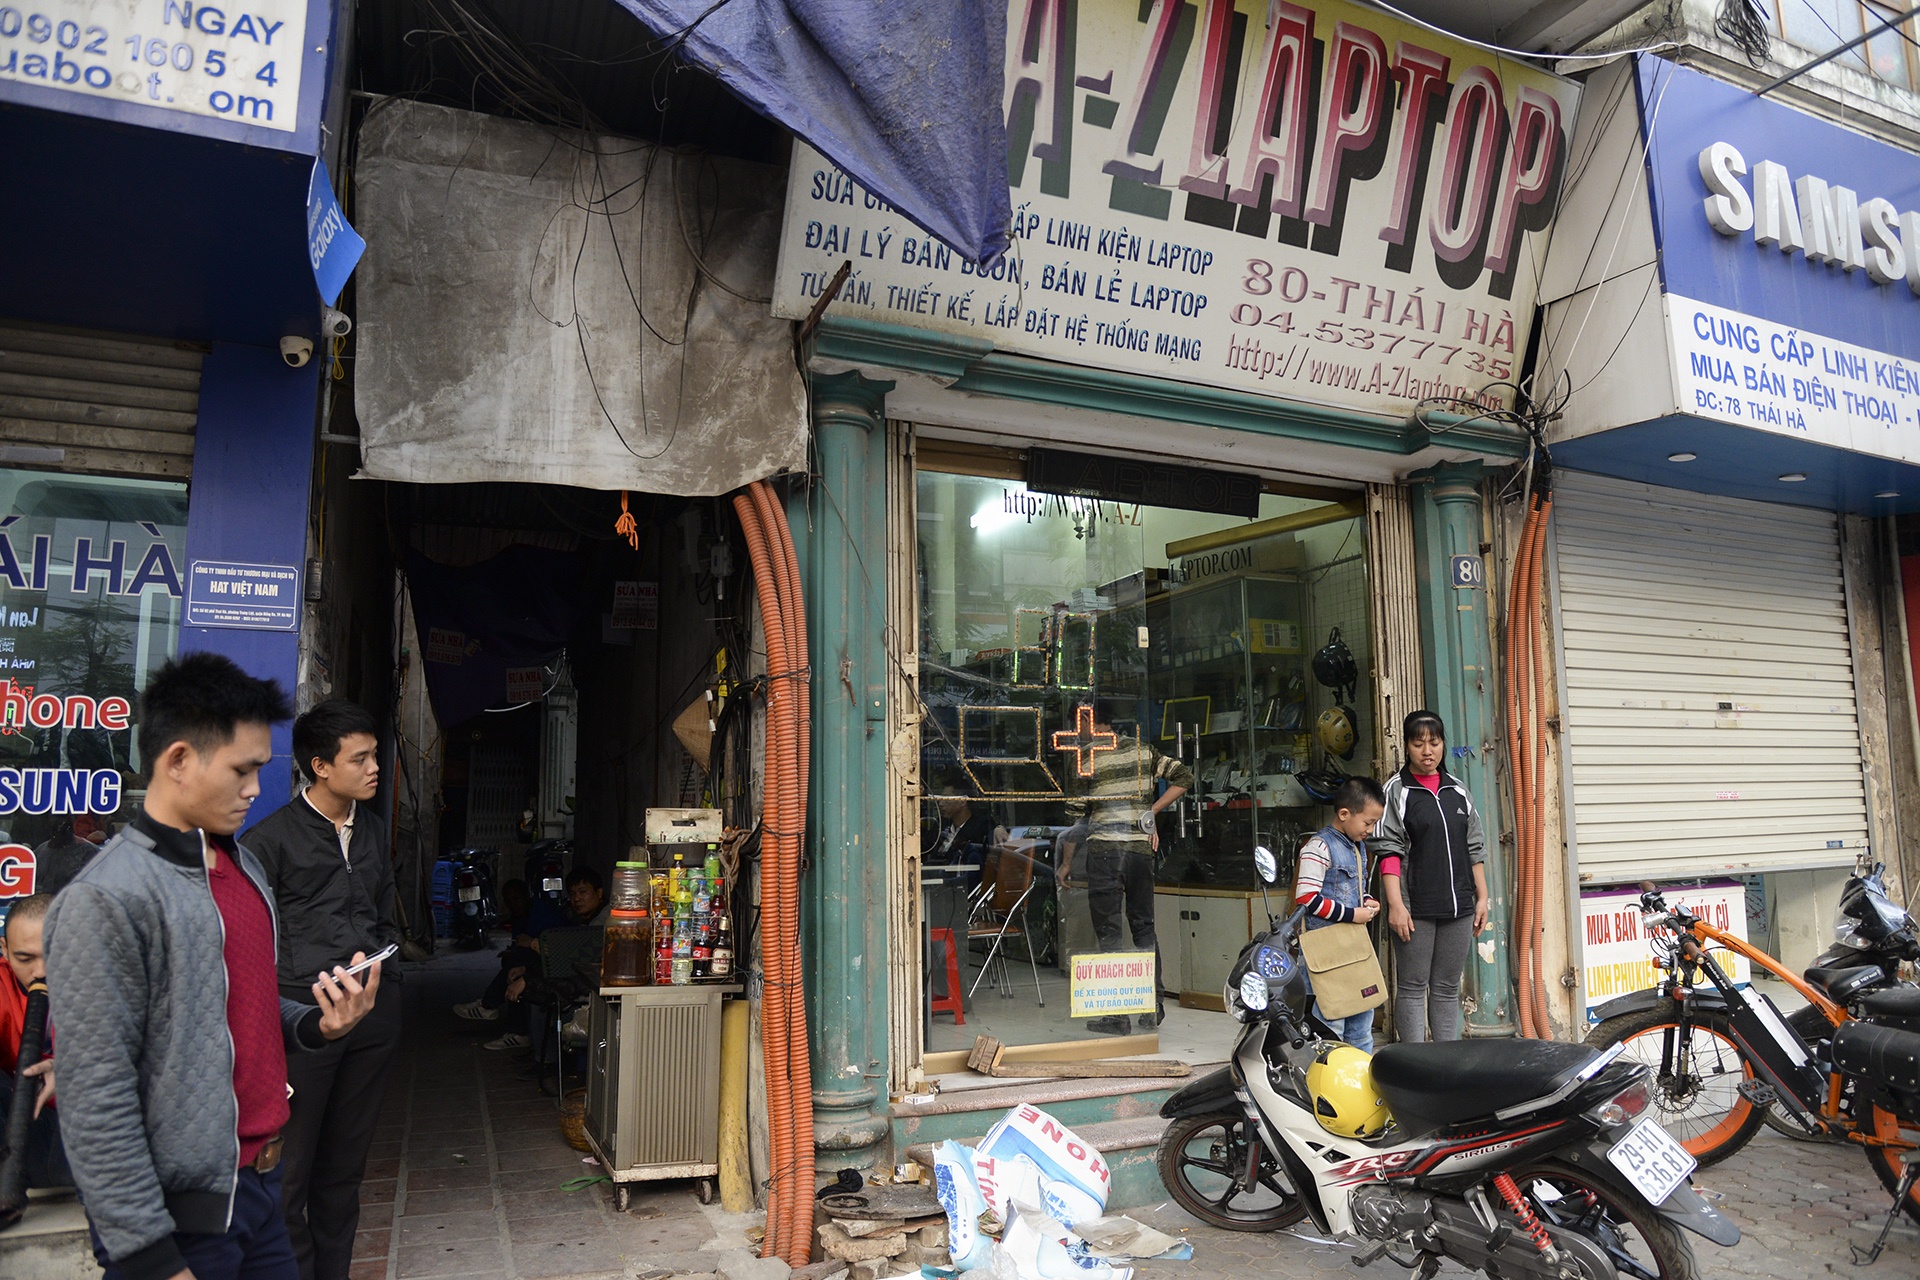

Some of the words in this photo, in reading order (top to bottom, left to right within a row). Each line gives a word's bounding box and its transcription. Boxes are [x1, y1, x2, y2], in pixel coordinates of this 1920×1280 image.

[0, 6, 109, 57] 0902
[163, 0, 284, 46] NGAY
[311, 201, 344, 270] Galaxy
[1010, 201, 1040, 240] ẤP
[1046, 217, 1091, 251] LINH
[1097, 226, 1142, 264] KIỆN
[1147, 239, 1214, 276] LAPTOP
[805, 220, 850, 257] ĐẠI
[860, 226, 892, 260] LÝ
[902, 234, 951, 271] BÁN
[1041, 261, 1087, 296] BÁN
[1095, 269, 1123, 304] LẺ
[1130, 281, 1207, 319] LAPTOP
[887, 282, 941, 316] THIẾT
[947, 289, 976, 326] KẾ,
[984, 294, 1019, 329] LẮP
[1025, 307, 1060, 339] ĐẶT
[1065, 314, 1089, 346] HỆ
[1095, 318, 1149, 353] THỐNG
[1155, 332, 1202, 362] MẠNG
[1229, 303, 1512, 380] 04.5377735
[1461, 309, 1515, 354] HÀ
[1693, 312, 1761, 354] CUNG
[1771, 330, 1815, 367] CẤP
[1822, 347, 1868, 383] LINH
[1874, 360, 1920, 399] KIỆN
[1690, 352, 1738, 387] MUA
[1743, 363, 1787, 398] BÁN
[1793, 376, 1837, 412] ĐIỆN
[1842, 390, 1898, 429] THOẠI
[1747, 401, 1782, 426] THÁI
[1786, 408, 1807, 431] HÀ
[70, 521, 182, 598] HÀ
[1170, 546, 1252, 584] LAPTOP.COM
[1459, 559, 1481, 583] 80
[210, 580, 229, 594] HAT
[231, 580, 253, 597] VIỆT
[254, 584, 279, 597] NAM
[1586, 913, 1611, 945] MUA
[1614, 905, 1637, 942] BÁN
[1715, 898, 1730, 931] CŨ
[1075, 962, 1093, 981] QUÝ
[1095, 961, 1124, 979] KHÁCH
[1126, 959, 1143, 978] CHÚ
[1086, 988, 1095, 997] XE
[1587, 963, 1613, 998] LINH
[1454, 1141, 1510, 1161] SIRIUS
[1618, 1125, 1664, 1172] 29-H1
[1637, 1144, 1690, 1198] 636.81
